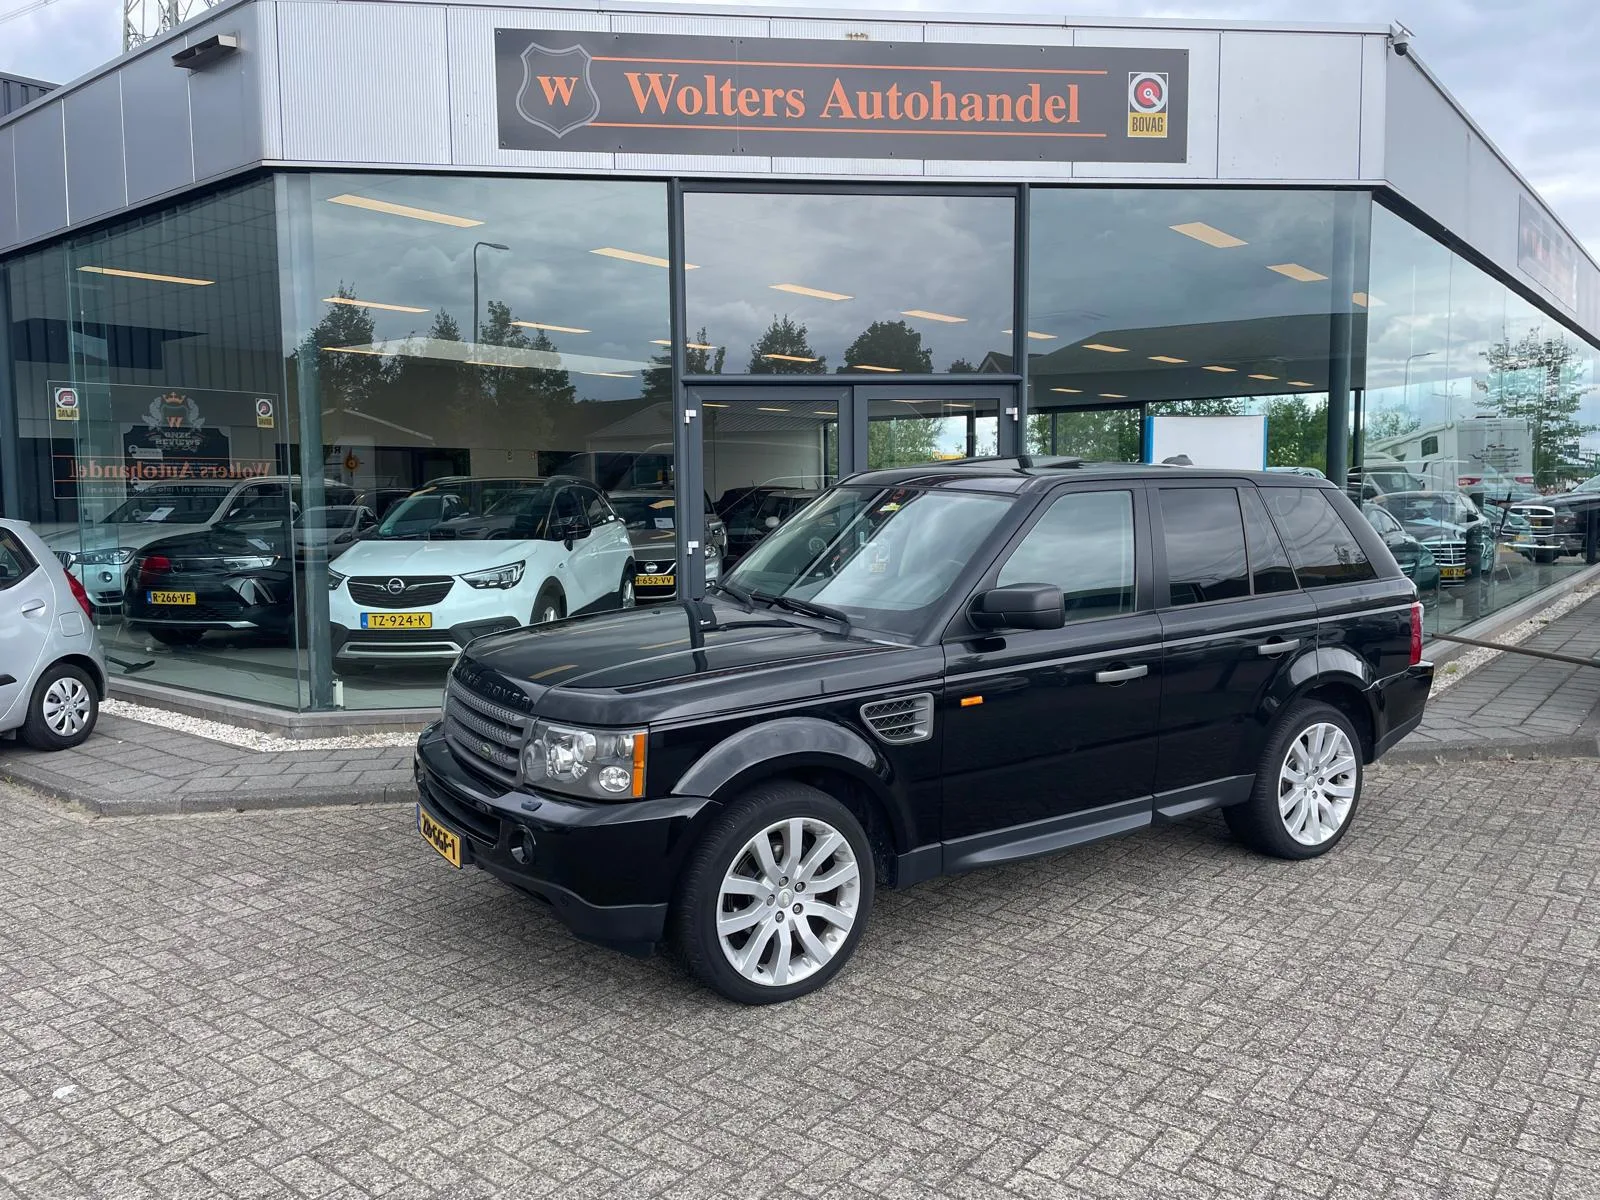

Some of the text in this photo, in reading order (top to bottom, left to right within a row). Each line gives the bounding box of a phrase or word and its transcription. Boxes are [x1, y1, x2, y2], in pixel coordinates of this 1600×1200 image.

[536, 76, 579, 106] W
[623, 72, 1080, 123] Wolters Autohandel
[1132, 116, 1163, 132] BOVAG
[152, 593, 191, 603] R-266-VF
[372, 615, 426, 626] TZ-924-K
